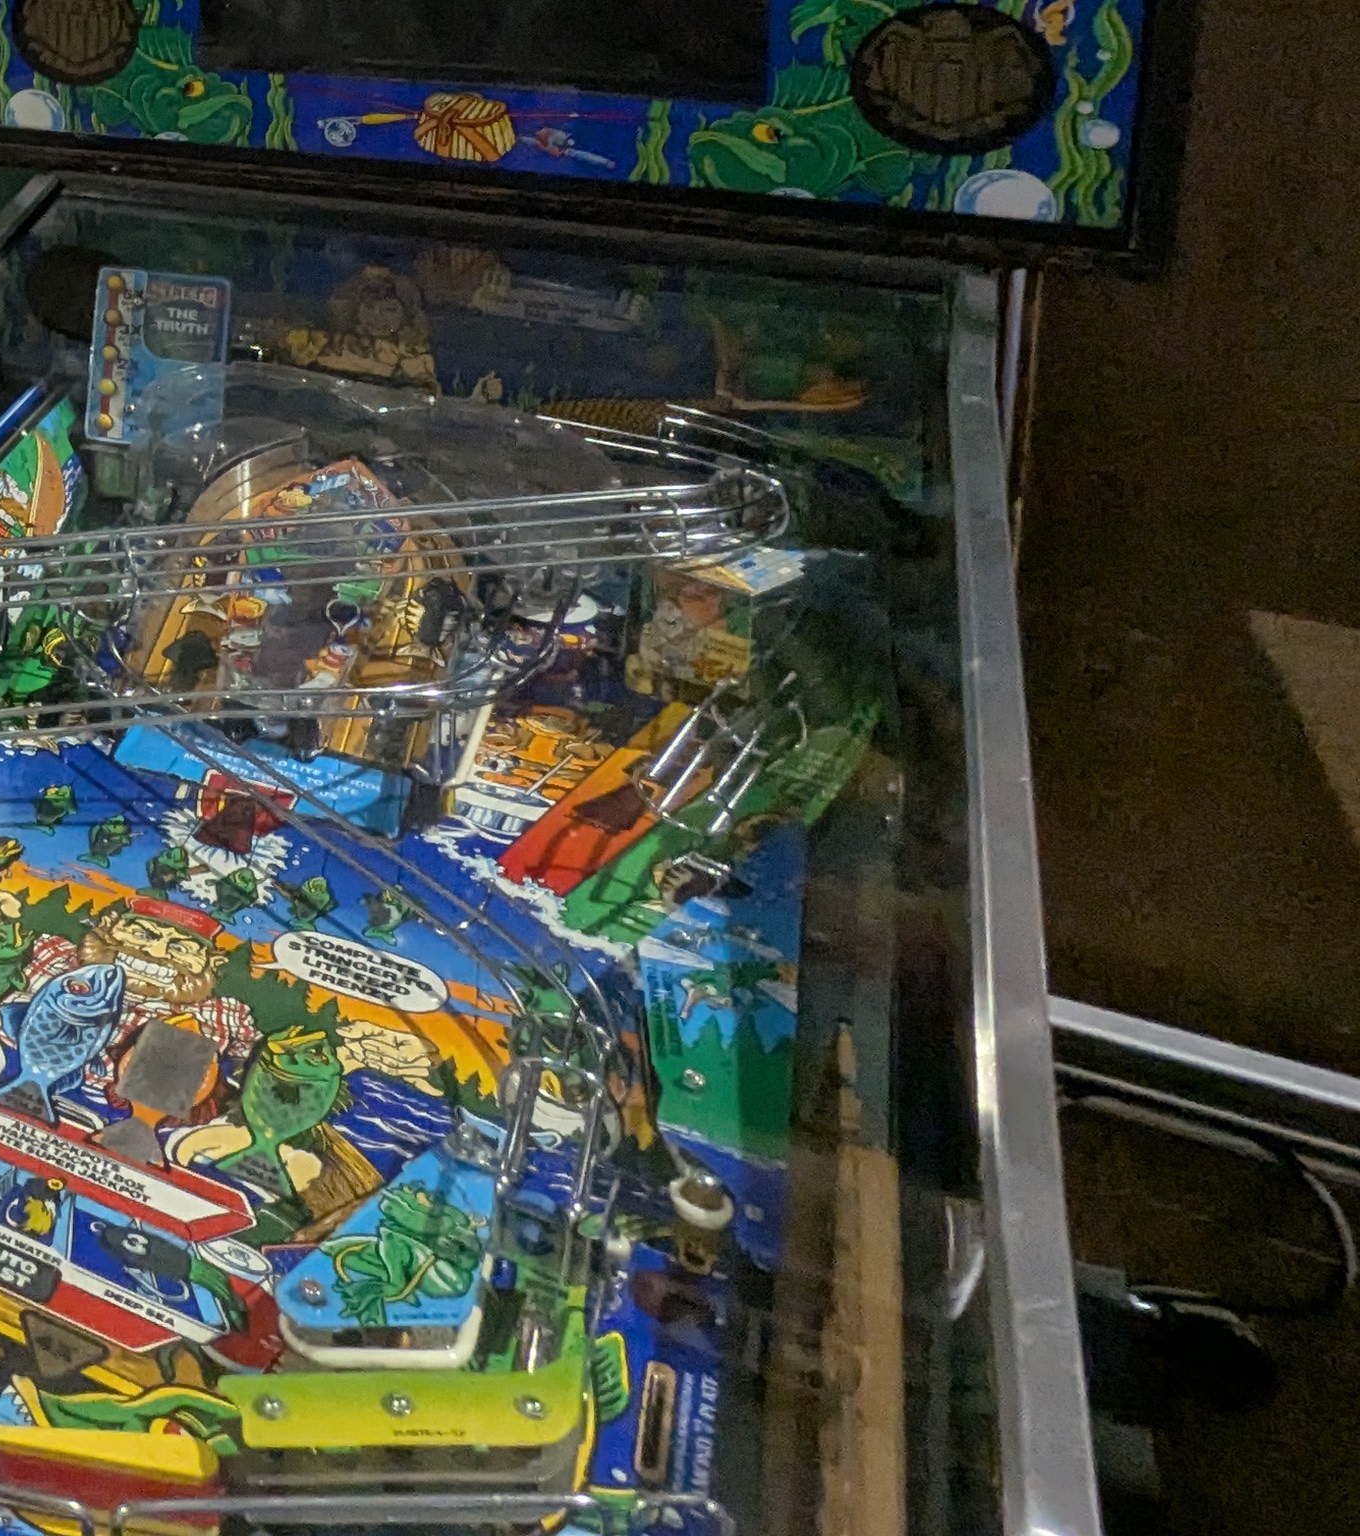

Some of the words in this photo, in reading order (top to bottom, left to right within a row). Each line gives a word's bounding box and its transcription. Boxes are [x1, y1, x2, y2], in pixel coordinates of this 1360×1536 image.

[154, 318, 210, 335] TRUTH
[166, 306, 199, 321] THE
[288, 941, 398, 982] STRINGER
[404, 976, 433, 992] TO
[302, 956, 351, 978] LITE
[353, 973, 411, 996] FEED
[304, 936, 422, 978] COMPLETE
[308, 969, 396, 1003] FRENZY
[11, 1120, 40, 1138] ALL
[40, 1133, 121, 1173] JACKPOTS
[25, 1147, 79, 1174] SUPER
[79, 1168, 152, 1203] JACKPOT
[53, 1148, 111, 1178] TACKLE
[111, 1173, 147, 1193] BOX
[14, 1237, 64, 1267] WATER
[104, 1288, 141, 1313] DEEP
[142, 1304, 177, 1328] SEA
